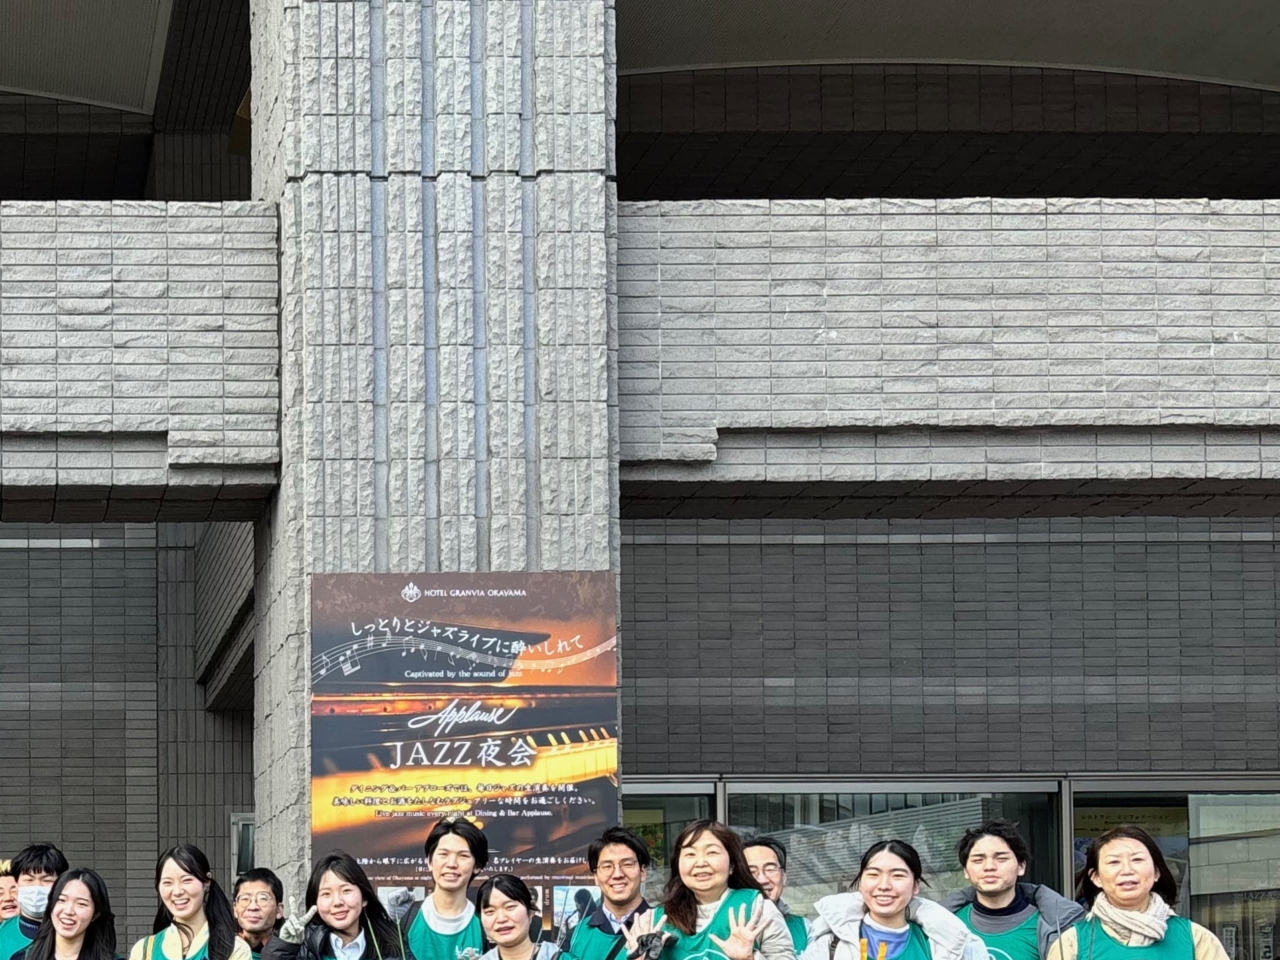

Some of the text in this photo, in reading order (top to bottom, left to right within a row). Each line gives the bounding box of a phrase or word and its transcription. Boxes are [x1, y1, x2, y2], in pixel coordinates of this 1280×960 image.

[424, 589, 527, 597] HOTEL GRANVIA OKAYAMA
[350, 616, 584, 657] しっとりとジャズライブに酔いしれて
[404, 669, 523, 679] Captivated by the sound of jazz
[407, 698, 519, 737] Applause
[390, 738, 538, 769] JAZZ夜会
[375, 809, 390, 817] Live
[391, 810, 405, 818] jazz
[406, 809, 425, 817] music
[426, 810, 446, 818] every
[475, 809, 498, 818] Dining
[507, 809, 520, 817] Bar
[521, 809, 553, 818] Applause.
